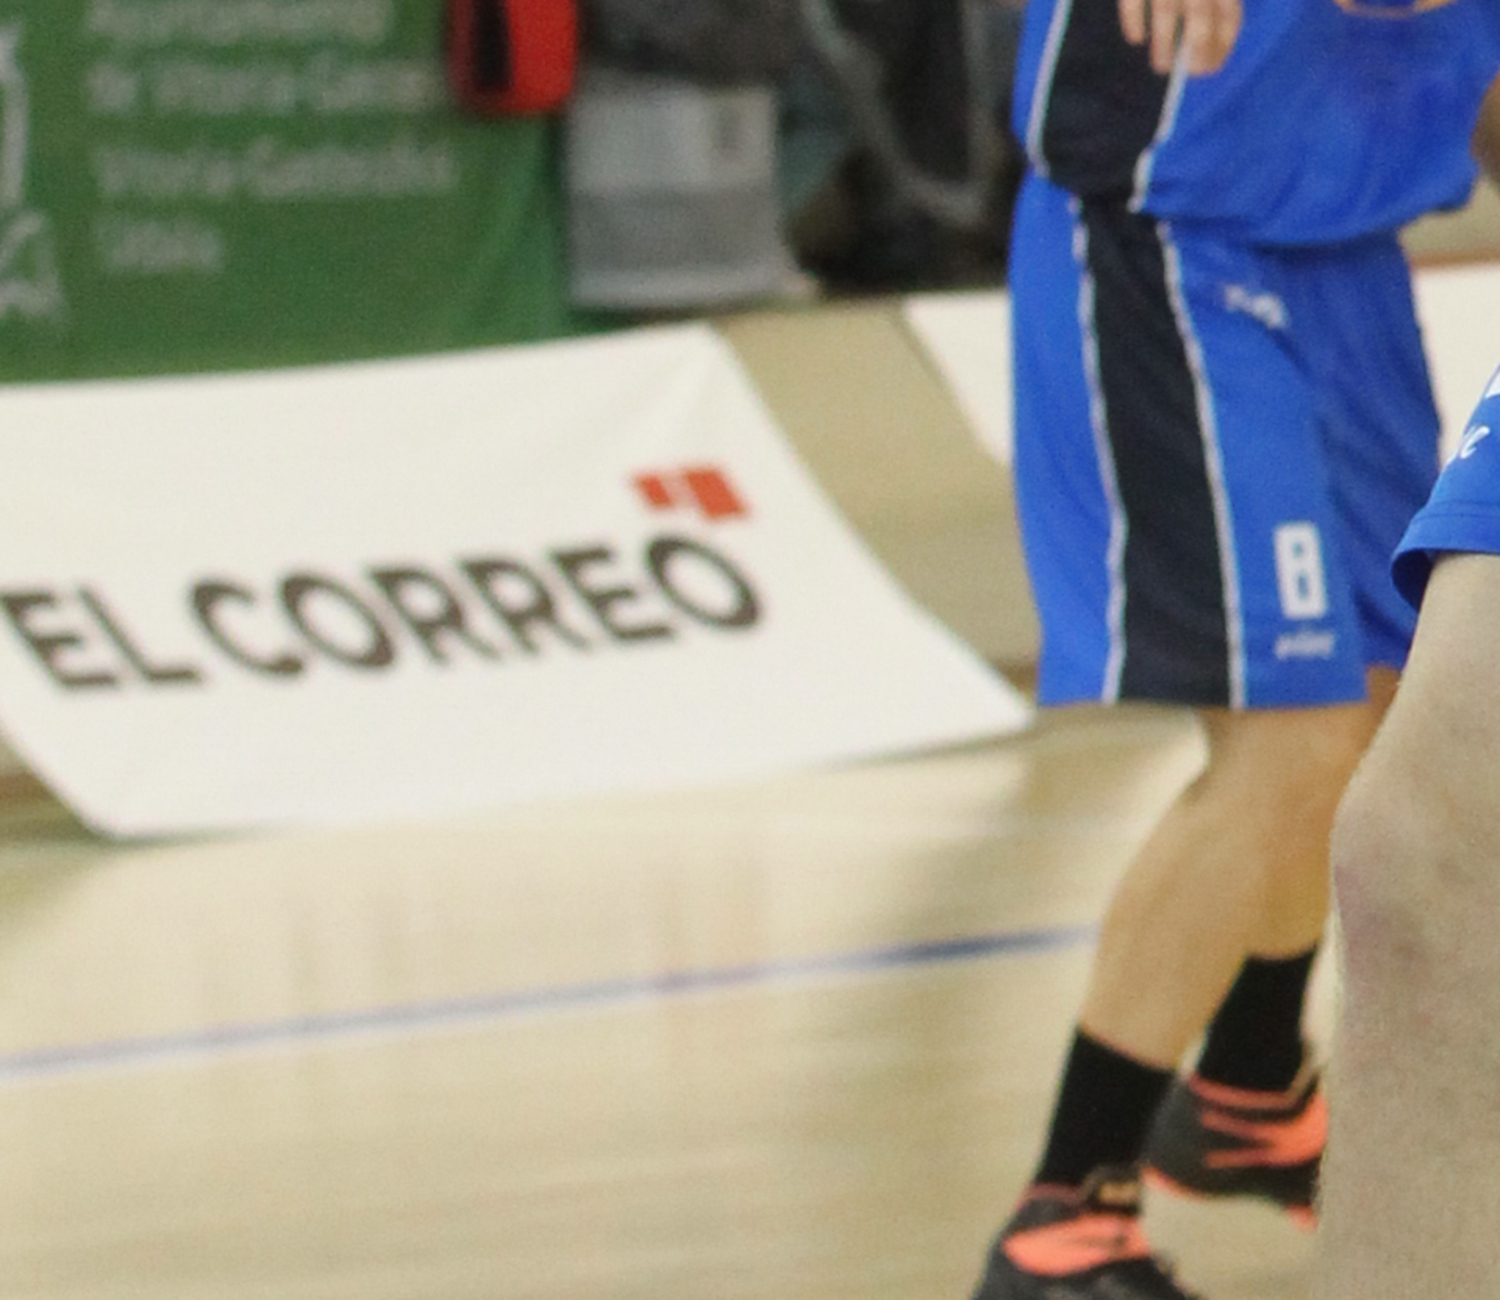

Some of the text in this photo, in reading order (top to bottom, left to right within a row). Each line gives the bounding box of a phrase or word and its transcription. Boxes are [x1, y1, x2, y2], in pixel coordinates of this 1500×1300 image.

[2, 534, 764, 691] EL CORREO
[1273, 521, 1329, 620] 8
